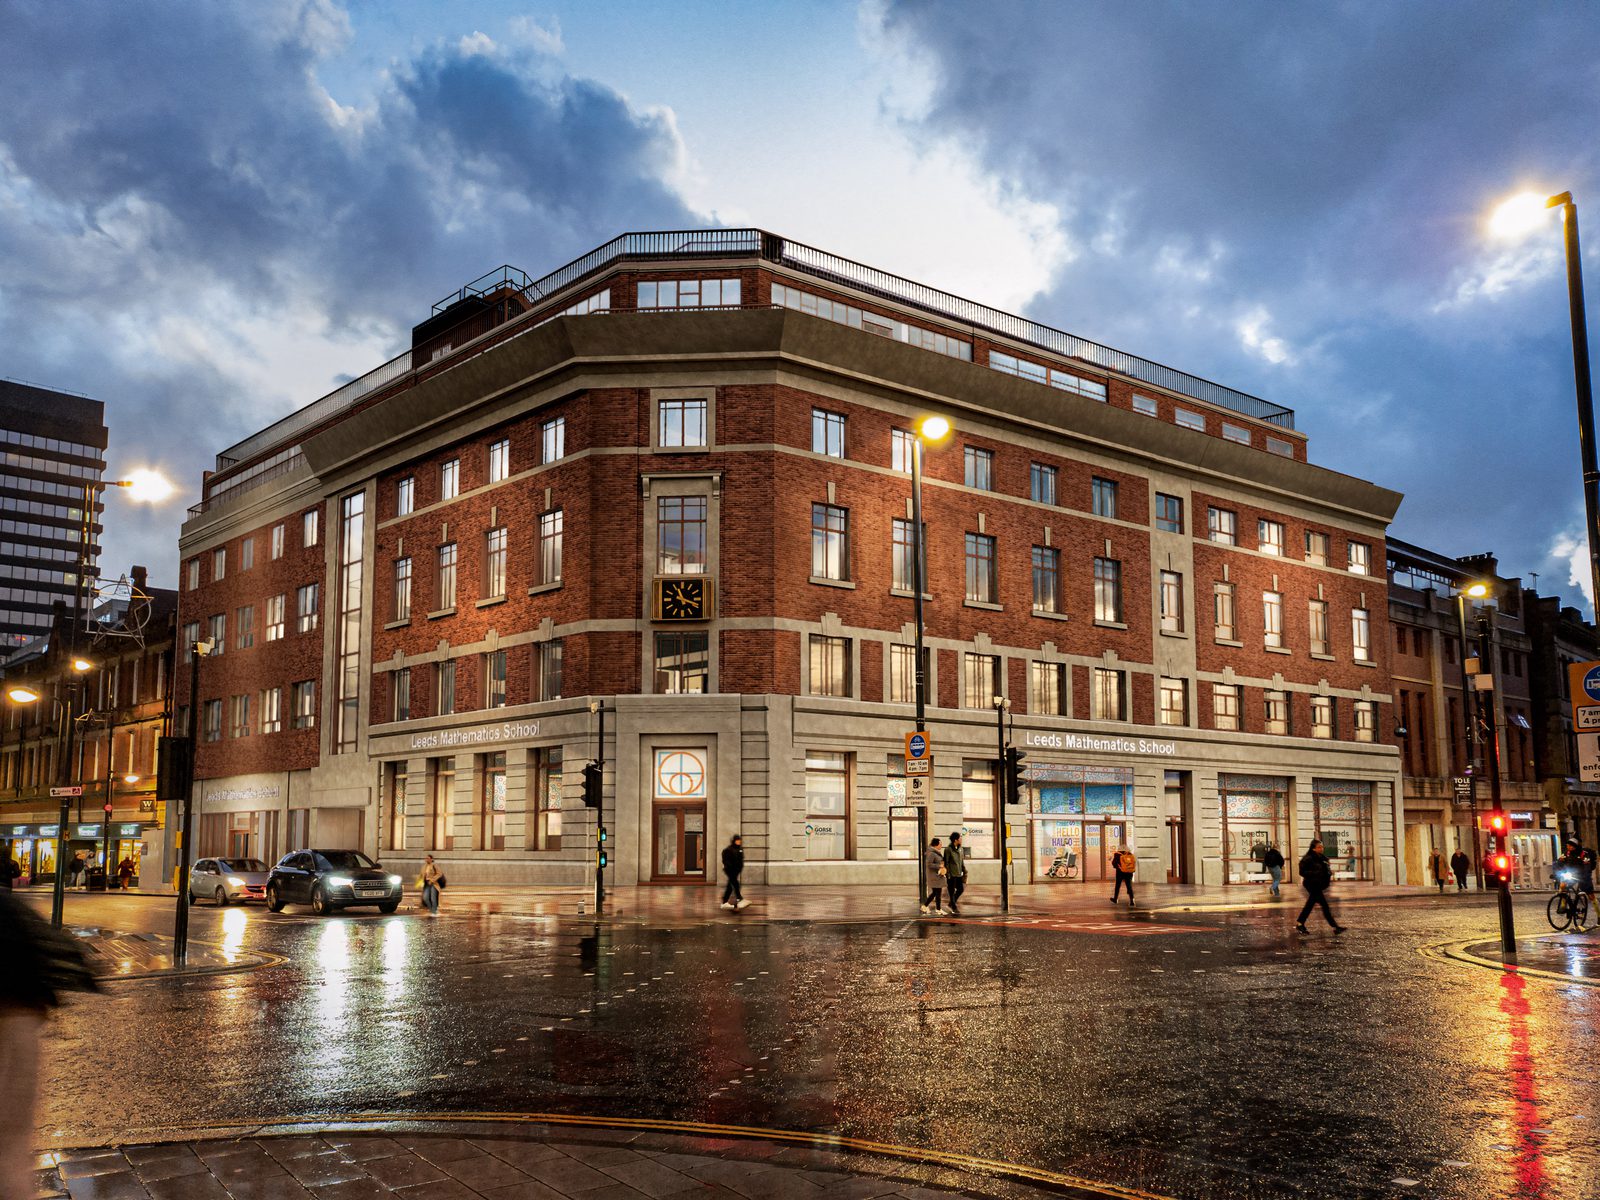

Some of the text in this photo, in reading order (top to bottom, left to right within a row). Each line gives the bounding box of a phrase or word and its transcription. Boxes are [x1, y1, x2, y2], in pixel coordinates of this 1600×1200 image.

[412, 721, 540, 748] Leeds Mathematics School
[1026, 732, 1175, 754] Leeds Mathematics School
[1057, 828, 1079, 837] HELLO
[1052, 838, 1072, 846] HALO
